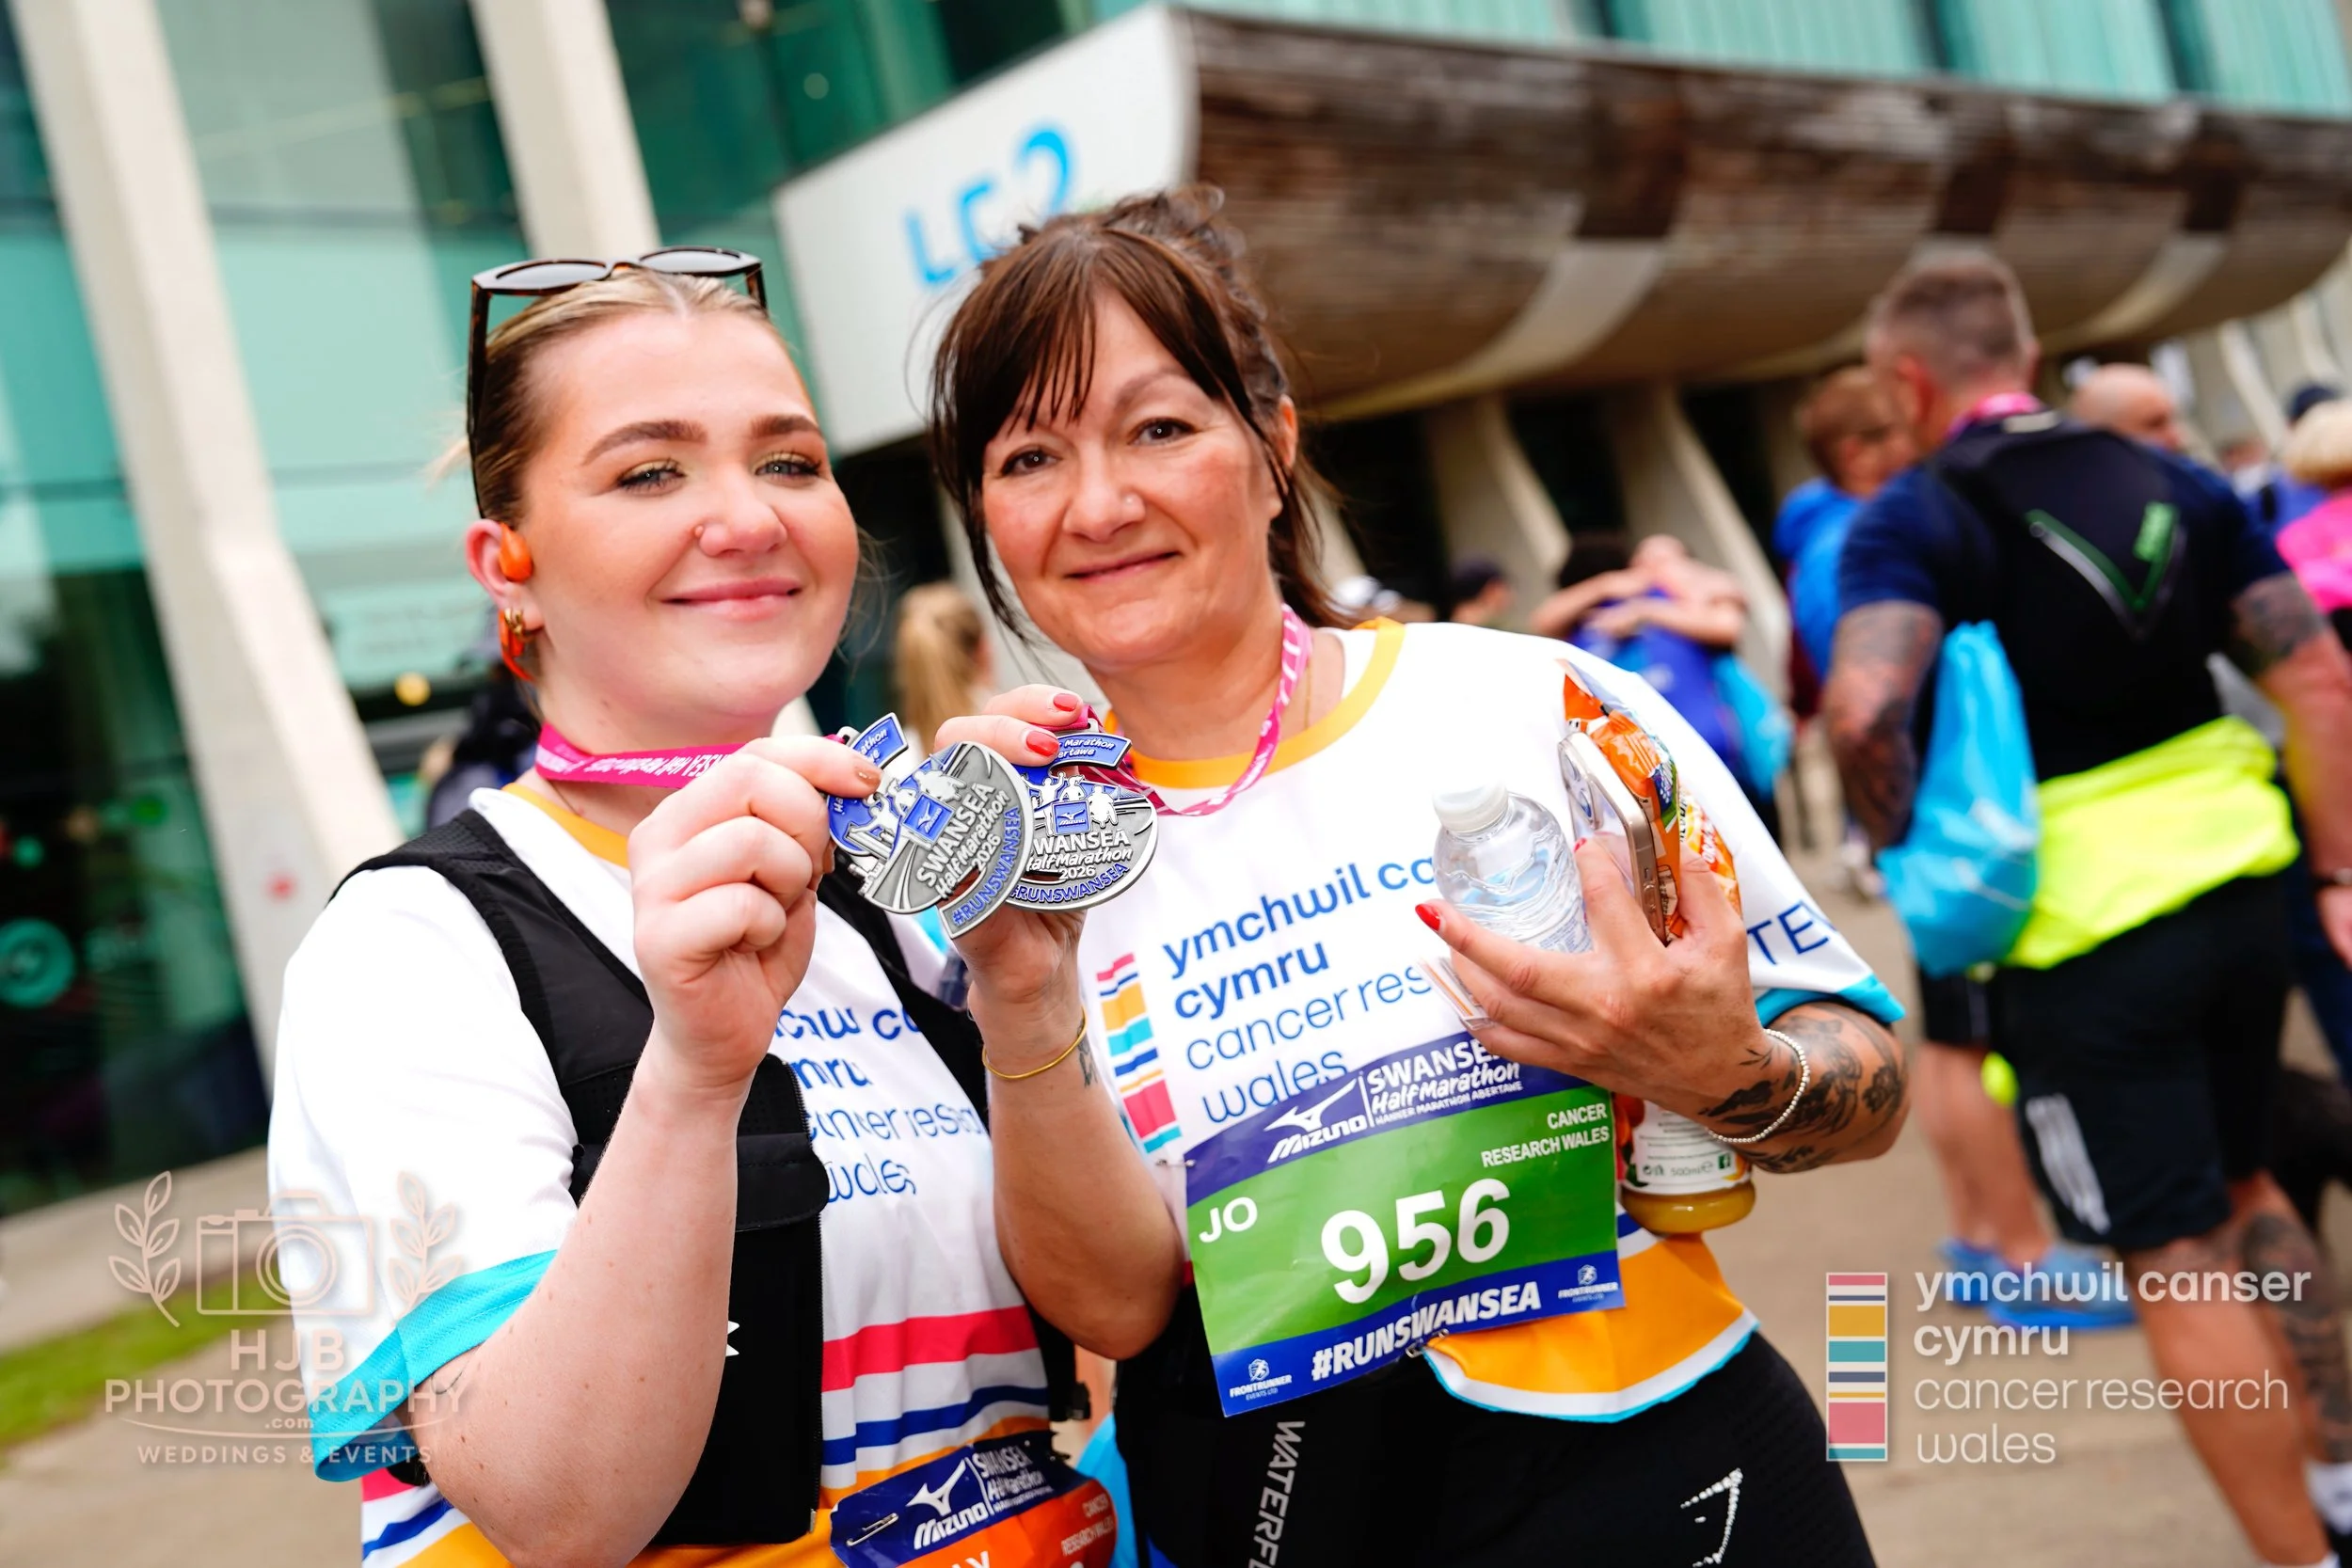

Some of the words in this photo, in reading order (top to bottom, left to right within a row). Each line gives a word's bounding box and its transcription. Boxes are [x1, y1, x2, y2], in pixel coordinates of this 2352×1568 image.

[860, 729, 887, 754] athon
[1057, 748, 1096, 758] ertawe
[1065, 737, 1115, 750] Marathon
[916, 782, 995, 887] SWANSEA
[972, 833, 1002, 873] 2026
[1033, 829, 1130, 855] WANSEA
[952, 806, 1021, 927] #RUNSWANSEA
[1058, 865, 1096, 880] 2026
[1162, 862, 1372, 978] ymchwil
[1174, 943, 1330, 1022] cymru
[1186, 987, 1352, 1070] cancer
[1202, 1050, 1348, 1124] wales
[1367, 1037, 1502, 1095] SWANSE
[1416, 1094, 1470, 1115] MARATHON
[1547, 1102, 1608, 1129] CANCER
[1481, 1135, 1561, 1167] RESEARCH
[1561, 1126, 1610, 1150] WALES
[1200, 1196, 1258, 1243] JO
[1321, 1178, 1511, 1305] 956
[1311, 1281, 1541, 1381] #RUNSWANSEA
[1248, 1420, 1306, 1568] WATERF
